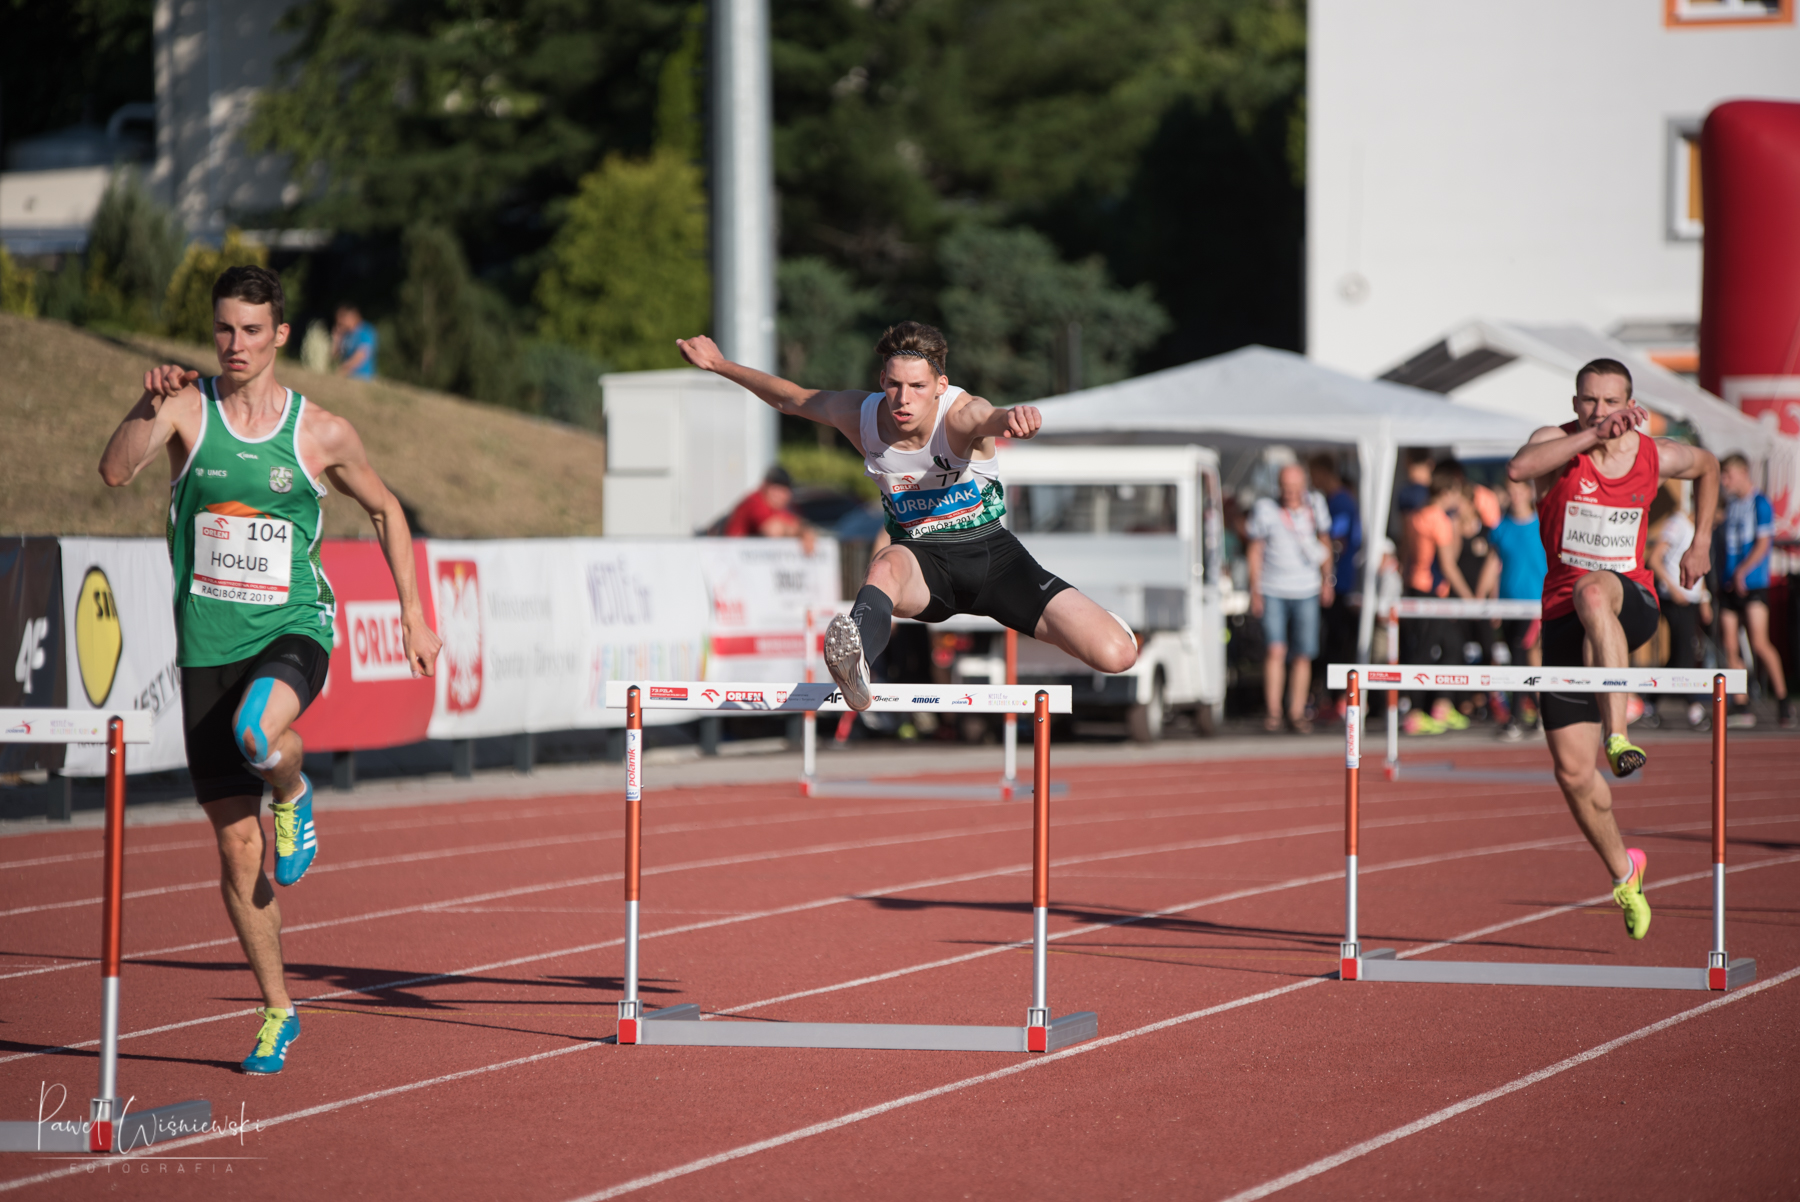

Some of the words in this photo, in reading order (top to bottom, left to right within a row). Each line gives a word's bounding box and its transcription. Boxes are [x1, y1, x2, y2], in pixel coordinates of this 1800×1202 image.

[207, 469, 227, 477] UMCS
[935, 471, 961, 487] 77
[895, 488, 977, 514] URBANIAK
[955, 512, 976, 524] 2019
[1608, 510, 1639, 525] 499
[203, 528, 229, 539] ORLEN
[247, 522, 287, 543] 104
[1566, 529, 1635, 548] JAKUBOWSKI
[210, 551, 269, 572] HOŁUB
[201, 585, 247, 601] RACIBÓRZ
[250, 593, 274, 602] 2019
[355, 616, 407, 667] ORLE
[1436, 675, 1467, 684] ORLEN
[1523, 676, 1542, 686] 4F
[727, 692, 762, 702] ORLEN
[823, 692, 843, 704] 4F
[627, 748, 637, 788] polanik
